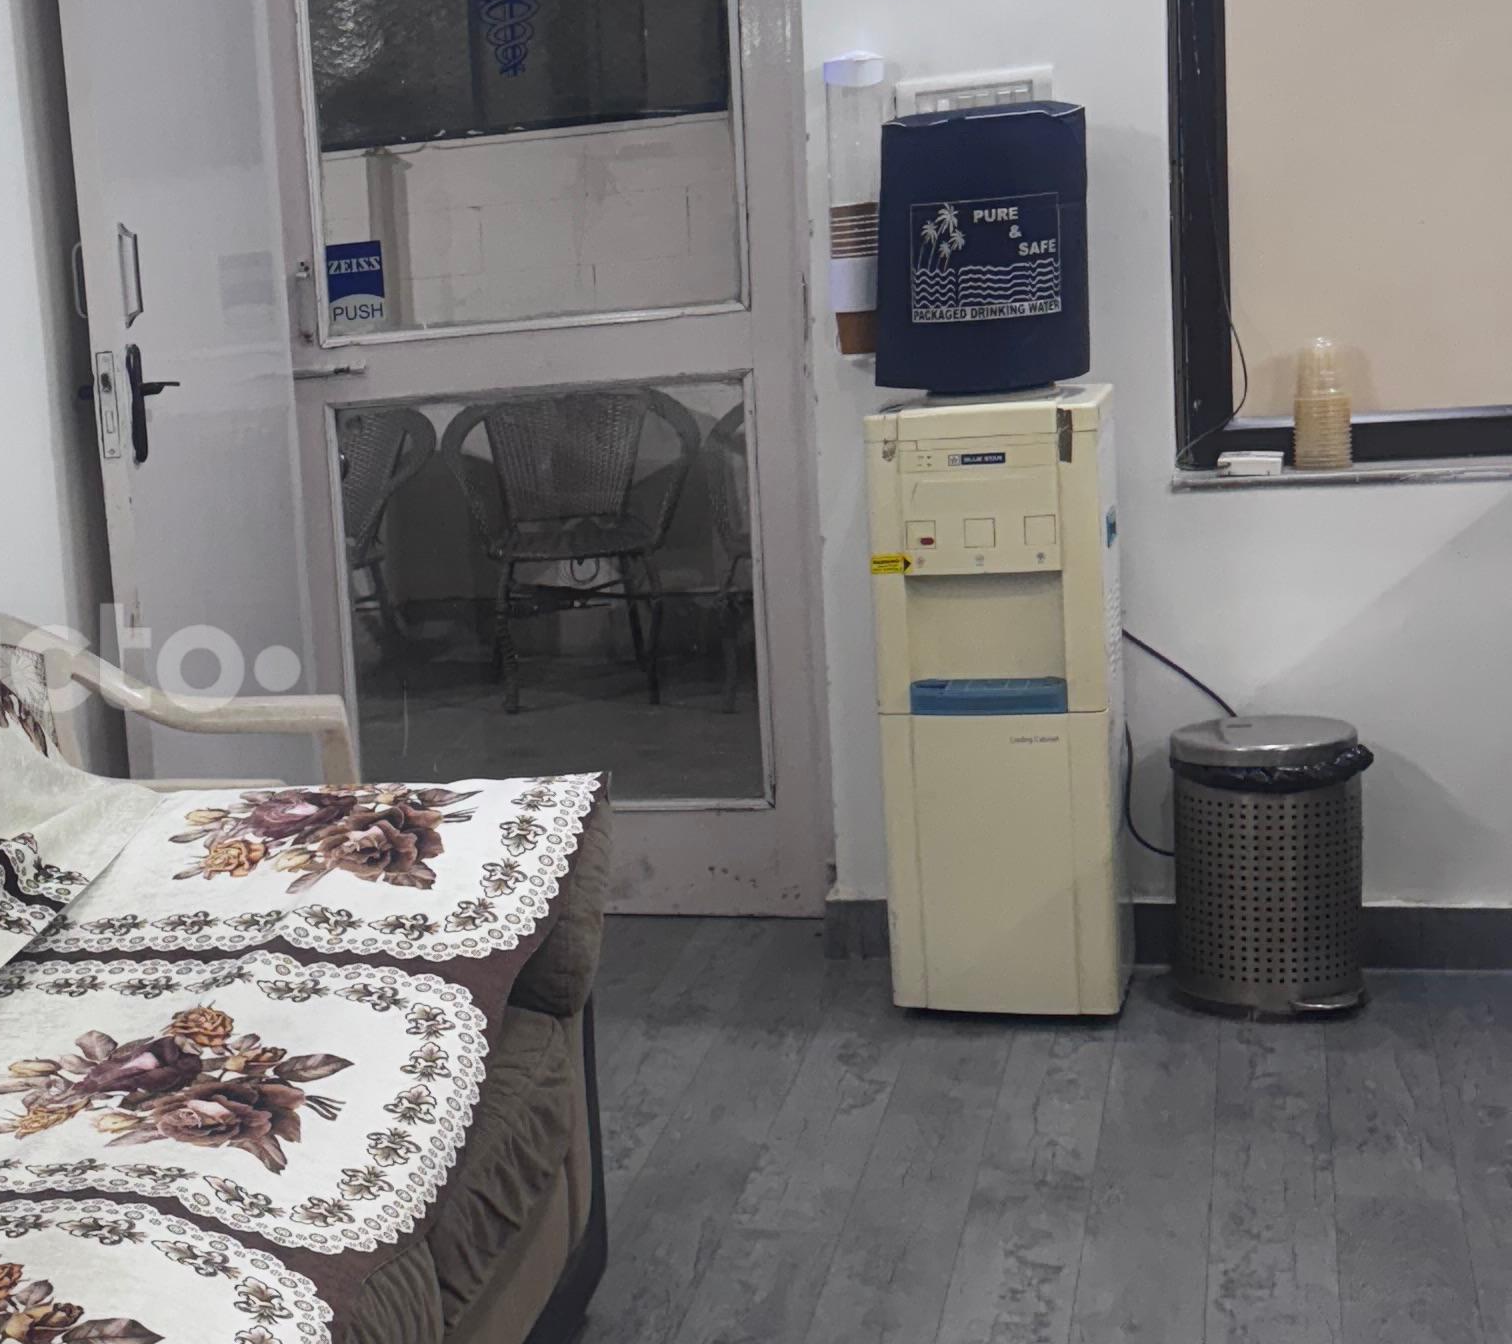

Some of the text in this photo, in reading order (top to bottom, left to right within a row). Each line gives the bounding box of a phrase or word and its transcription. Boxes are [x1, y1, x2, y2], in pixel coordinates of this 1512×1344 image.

[973, 207, 1019, 223] PURE
[1008, 224, 1022, 239] &
[1018, 238, 1057, 256] SAFE
[328, 256, 381, 275] ZEISS
[332, 303, 384, 321] PUSH
[913, 299, 1060, 321] PACKAGED DRINKING WATER
